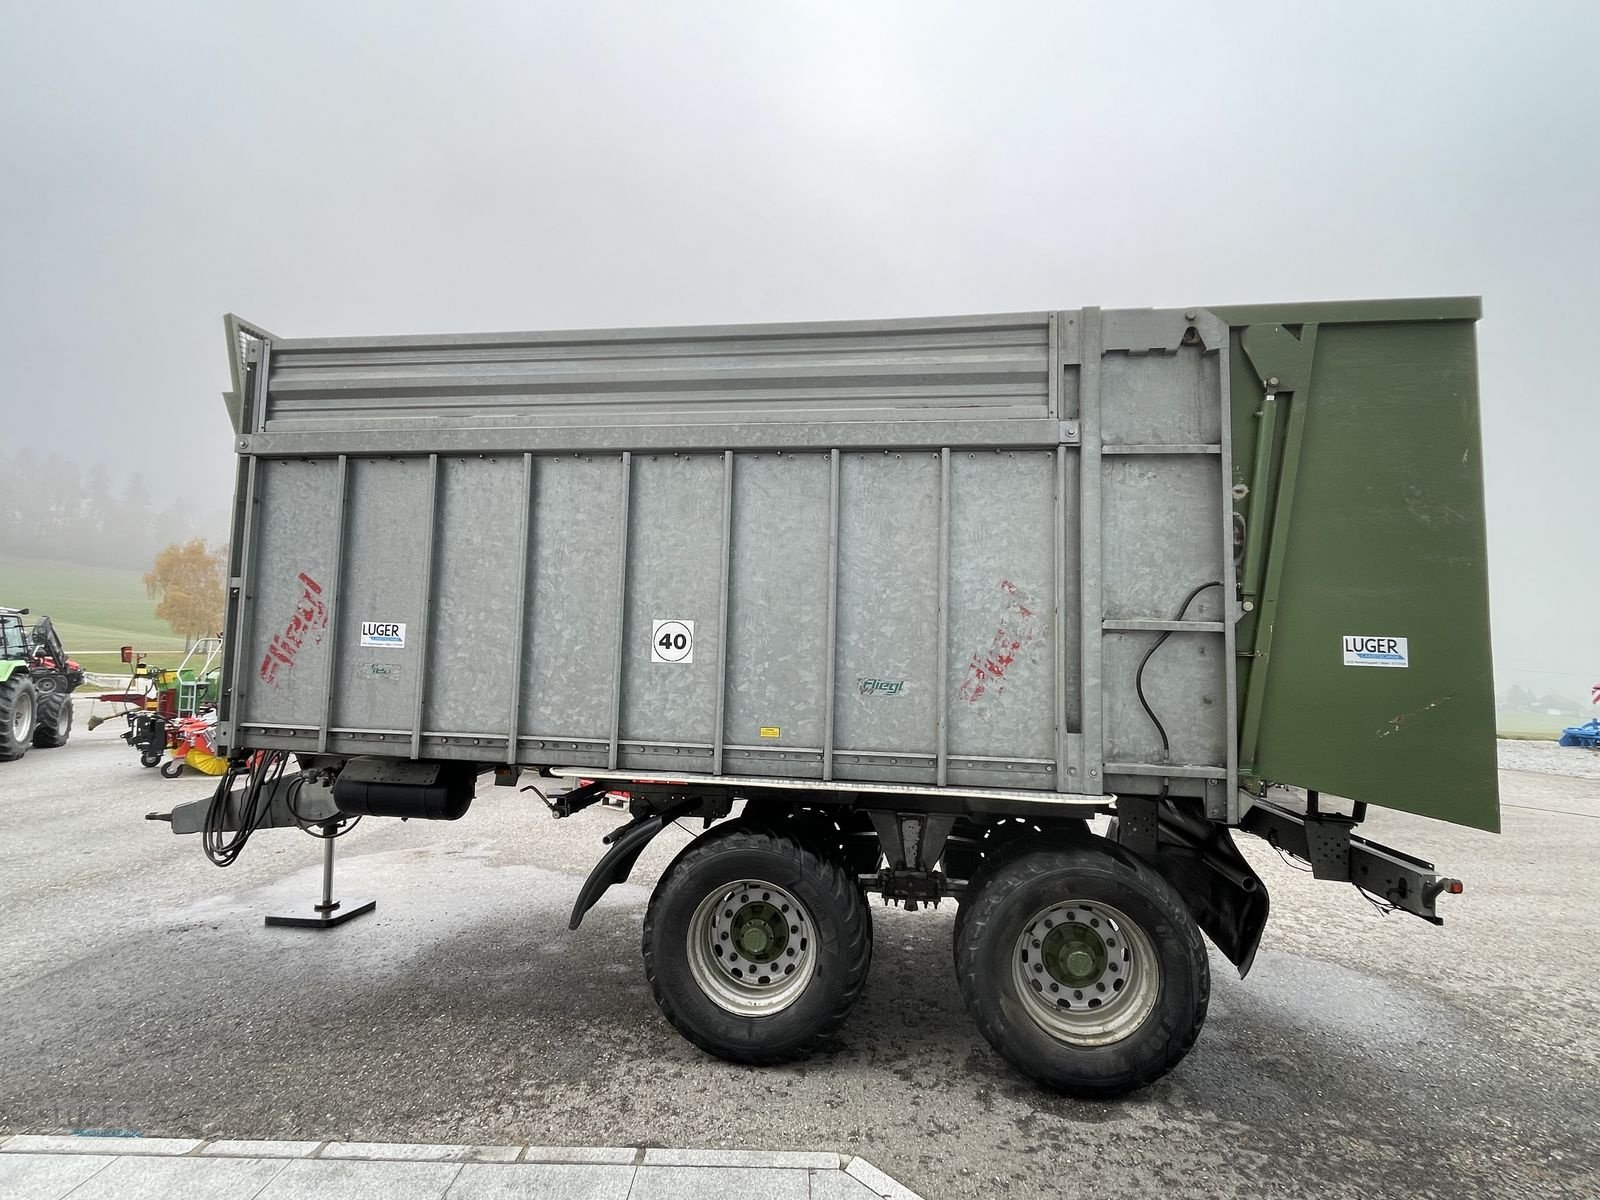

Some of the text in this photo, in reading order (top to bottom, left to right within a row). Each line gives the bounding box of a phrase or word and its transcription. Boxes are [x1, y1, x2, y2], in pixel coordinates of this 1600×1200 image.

[362, 623, 399, 637] LUGER
[658, 633, 687, 650] 40
[1345, 637, 1399, 654] LUGER
